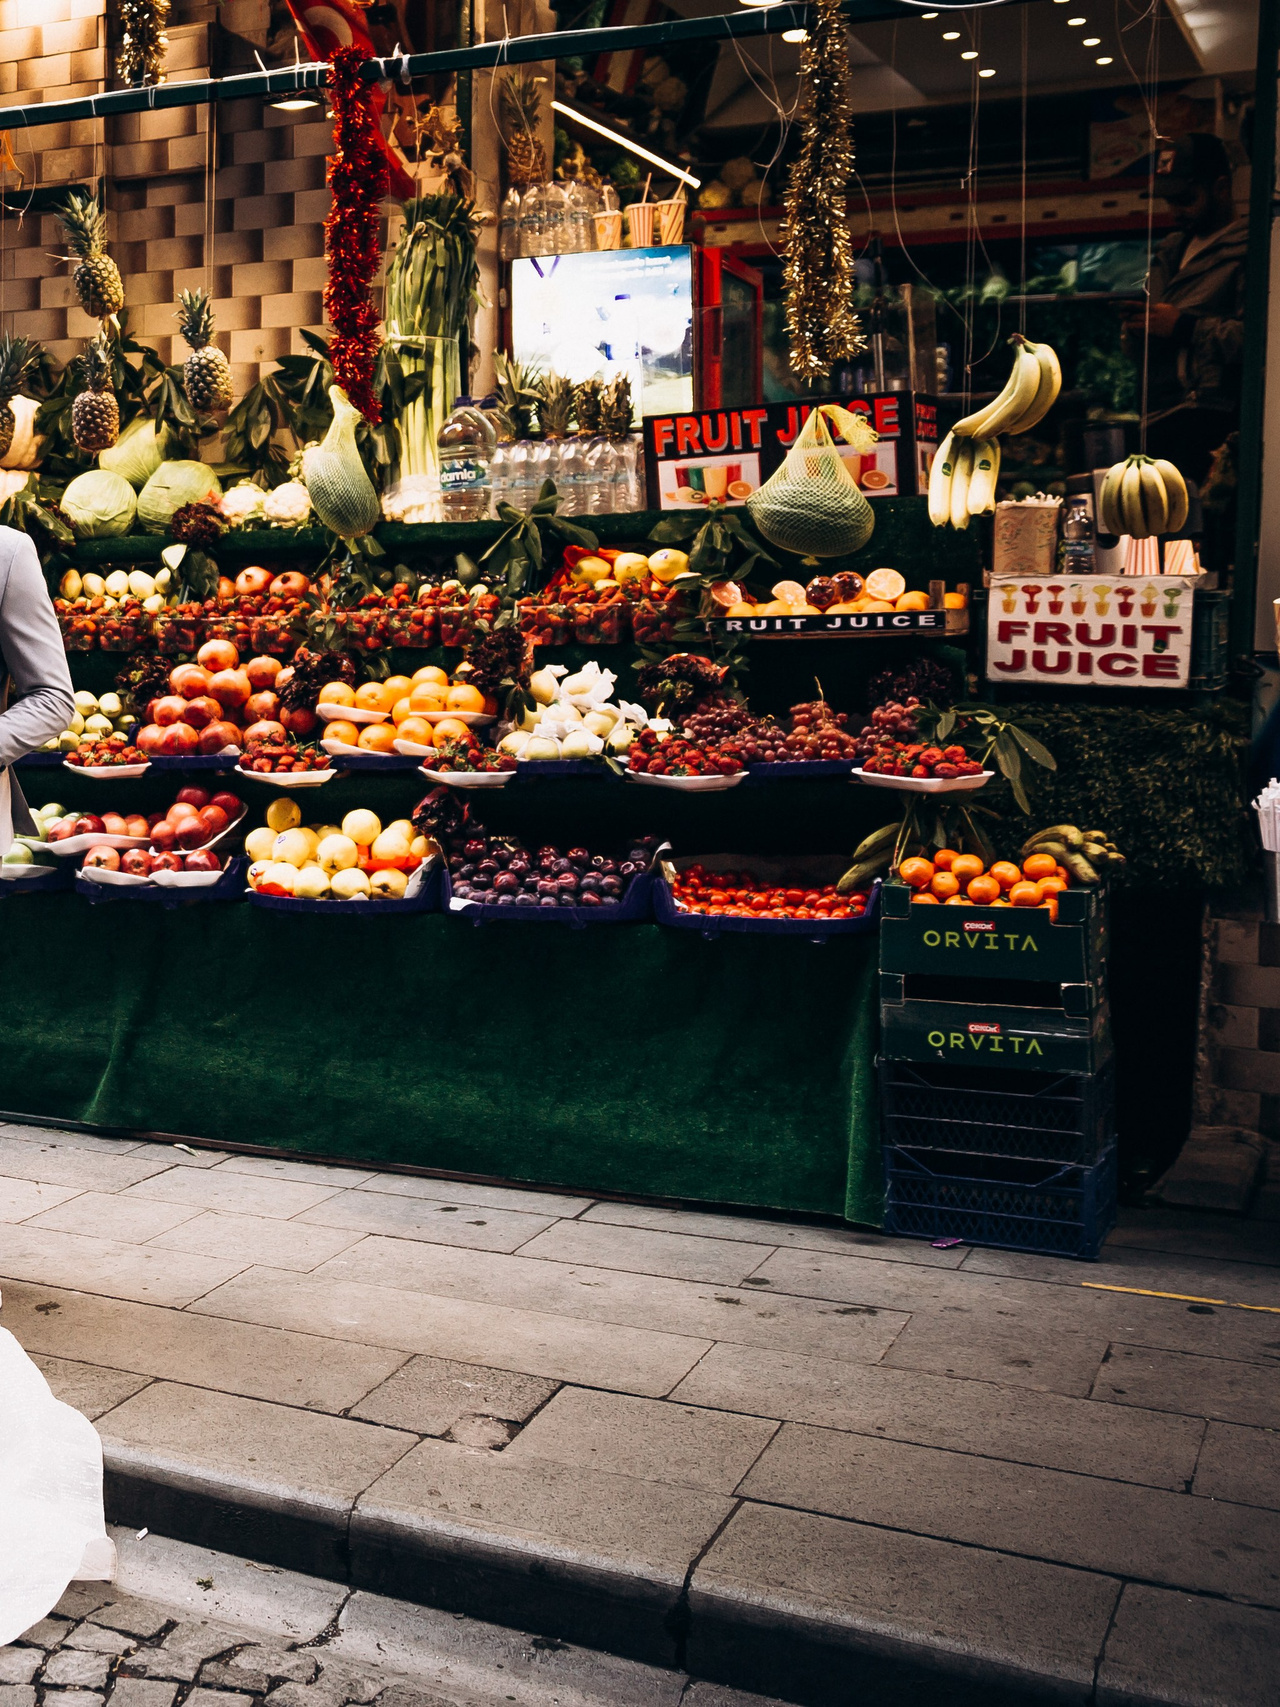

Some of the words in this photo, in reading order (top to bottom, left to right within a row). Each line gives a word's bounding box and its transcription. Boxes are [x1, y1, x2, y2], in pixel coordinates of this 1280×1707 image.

[652, 409, 768, 457] FRUIT
[440, 470, 477, 482] damla
[826, 614, 937, 629] JUICE
[997, 620, 1183, 649] FRUIT
[993, 648, 1181, 680] JUICE
[923, 930, 1038, 952] ORVITA
[927, 1030, 1044, 1055] ORVITA
